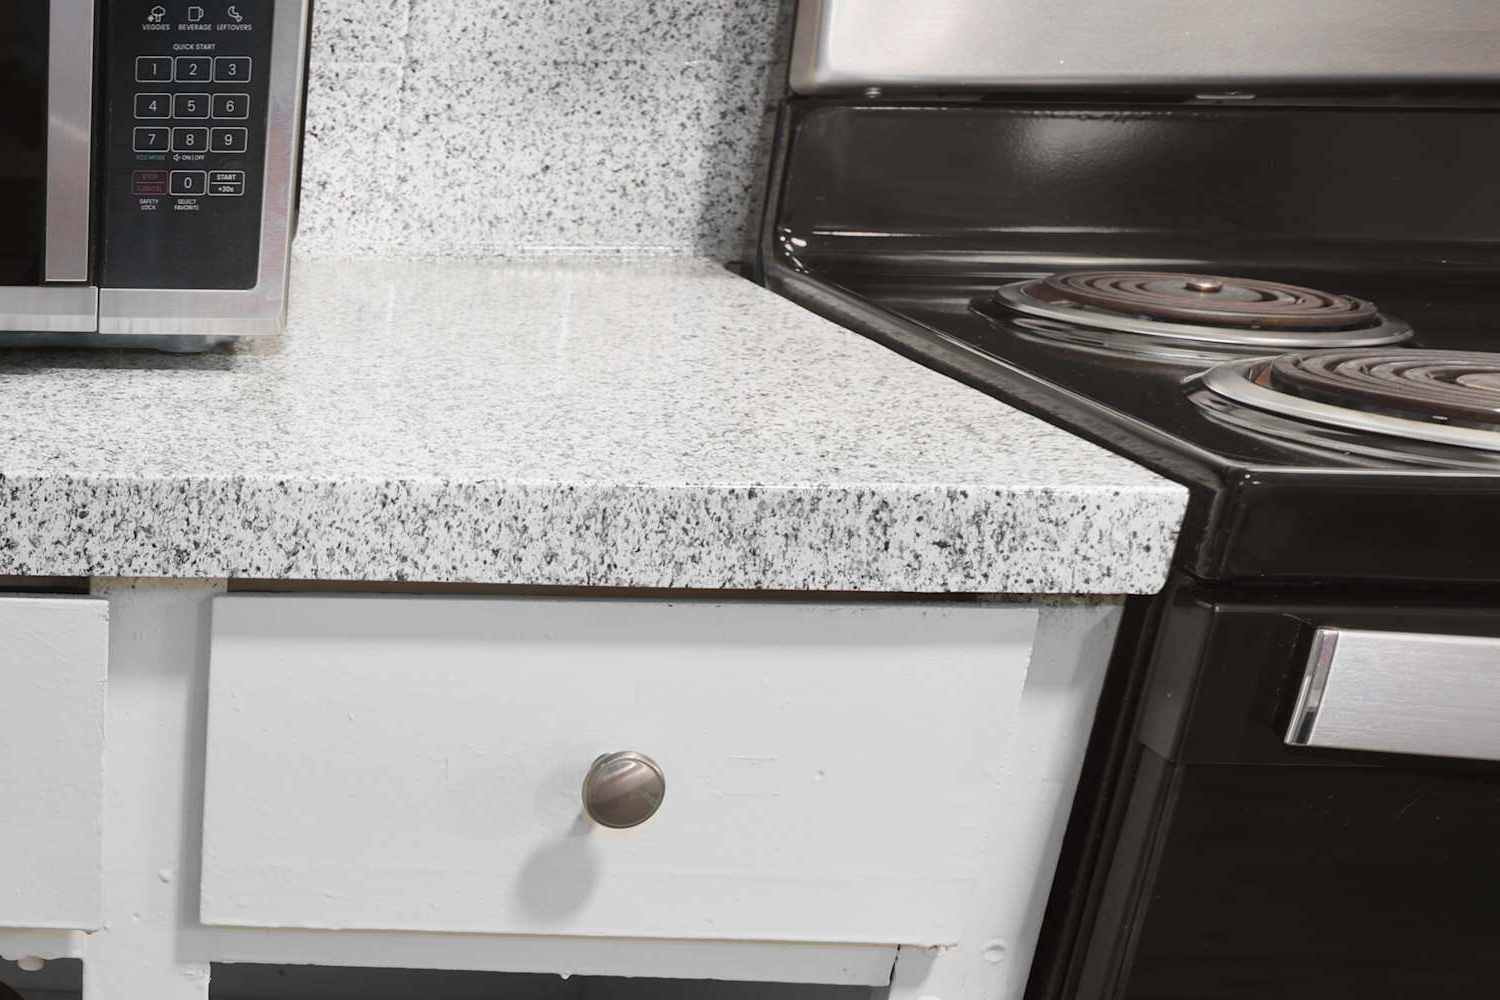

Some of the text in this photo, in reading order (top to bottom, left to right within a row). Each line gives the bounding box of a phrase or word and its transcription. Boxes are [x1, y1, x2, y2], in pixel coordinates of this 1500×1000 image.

[152, 63, 157, 75] 1
[189, 63, 197, 76] 2
[228, 63, 237, 76] 3
[148, 100, 157, 112] 4
[187, 100, 196, 112] 5
[226, 100, 235, 112] 6
[148, 133, 156, 145] 7
[186, 133, 194, 146] 8
[224, 133, 233, 146] 9
[183, 177, 192, 189] 0
